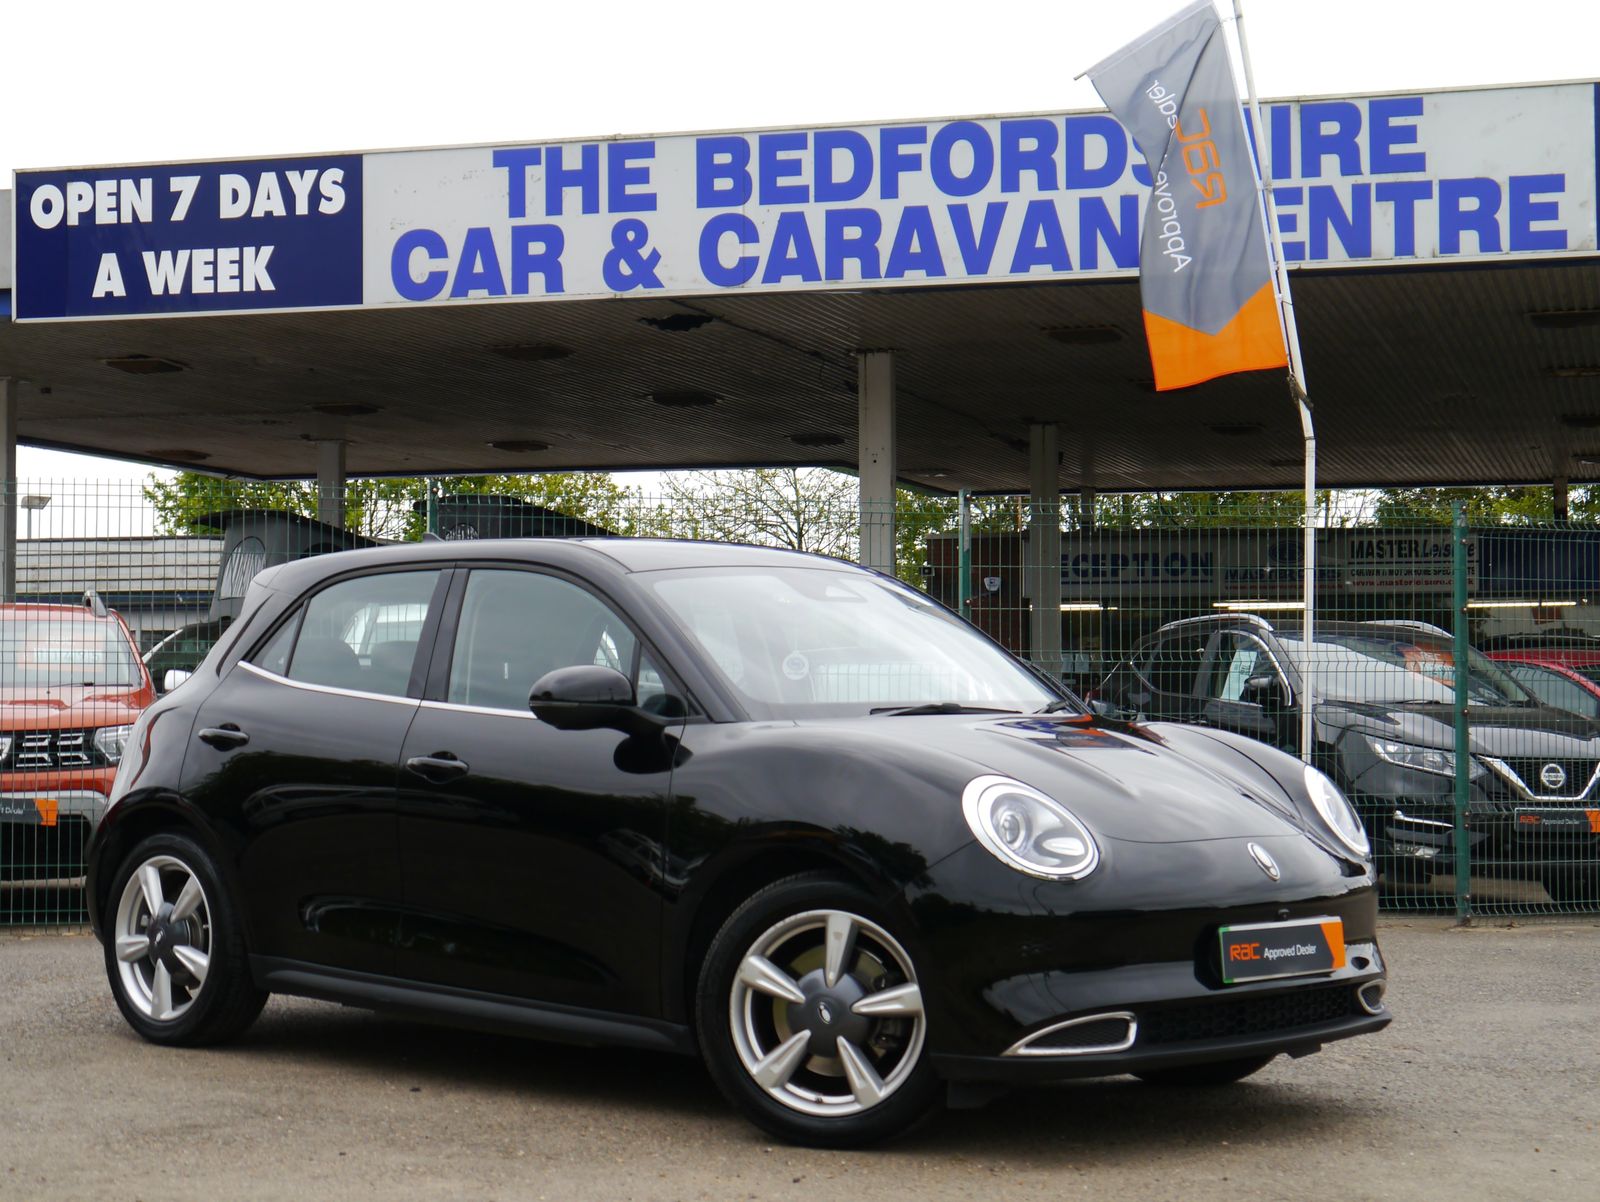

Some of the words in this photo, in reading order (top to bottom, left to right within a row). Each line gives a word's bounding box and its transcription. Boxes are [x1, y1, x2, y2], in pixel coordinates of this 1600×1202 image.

[493, 142, 657, 219] THE
[697, 97, 1426, 209] BEDFORDIRE
[30, 178, 153, 230] OPEN
[169, 175, 201, 222] 7
[219, 167, 346, 219] DAYS
[391, 217, 565, 302] CAR
[602, 219, 664, 292] &
[697, 195, 1140, 287] CARAVAN
[1268, 174, 1568, 262] ENTRE
[92, 252, 127, 298] A
[141, 245, 276, 295] WEEK
[1060, 551, 1214, 578] ECEPTION
[1350, 540, 1419, 559] MASTER
[1422, 539, 1475, 558] Leise
[1263, 945, 1296, 960] Approved
[1296, 943, 1317, 956] Dealer
